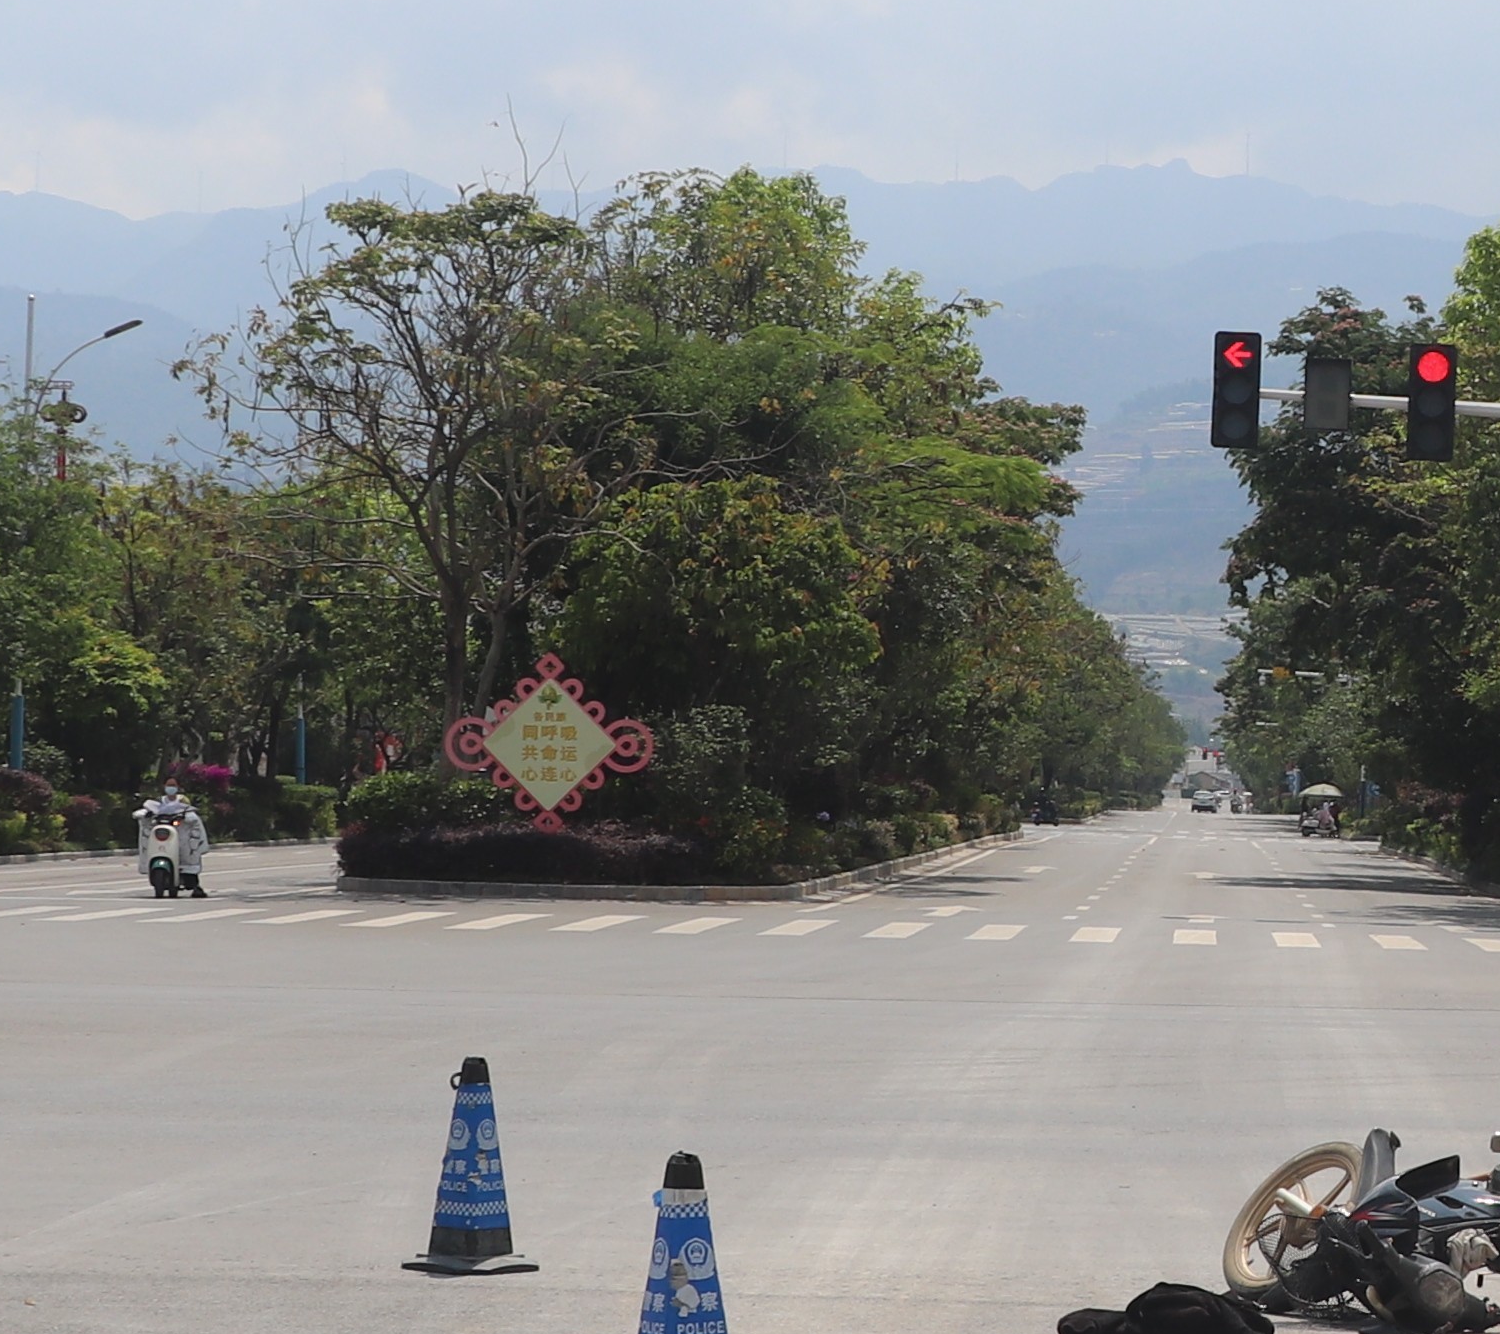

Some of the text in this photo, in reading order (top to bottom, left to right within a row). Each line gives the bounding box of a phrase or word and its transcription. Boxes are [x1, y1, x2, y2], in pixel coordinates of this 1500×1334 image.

[522, 725, 578, 741] 同呼吸
[521, 745, 578, 762] 共命运
[521, 767, 577, 782] 心连心
